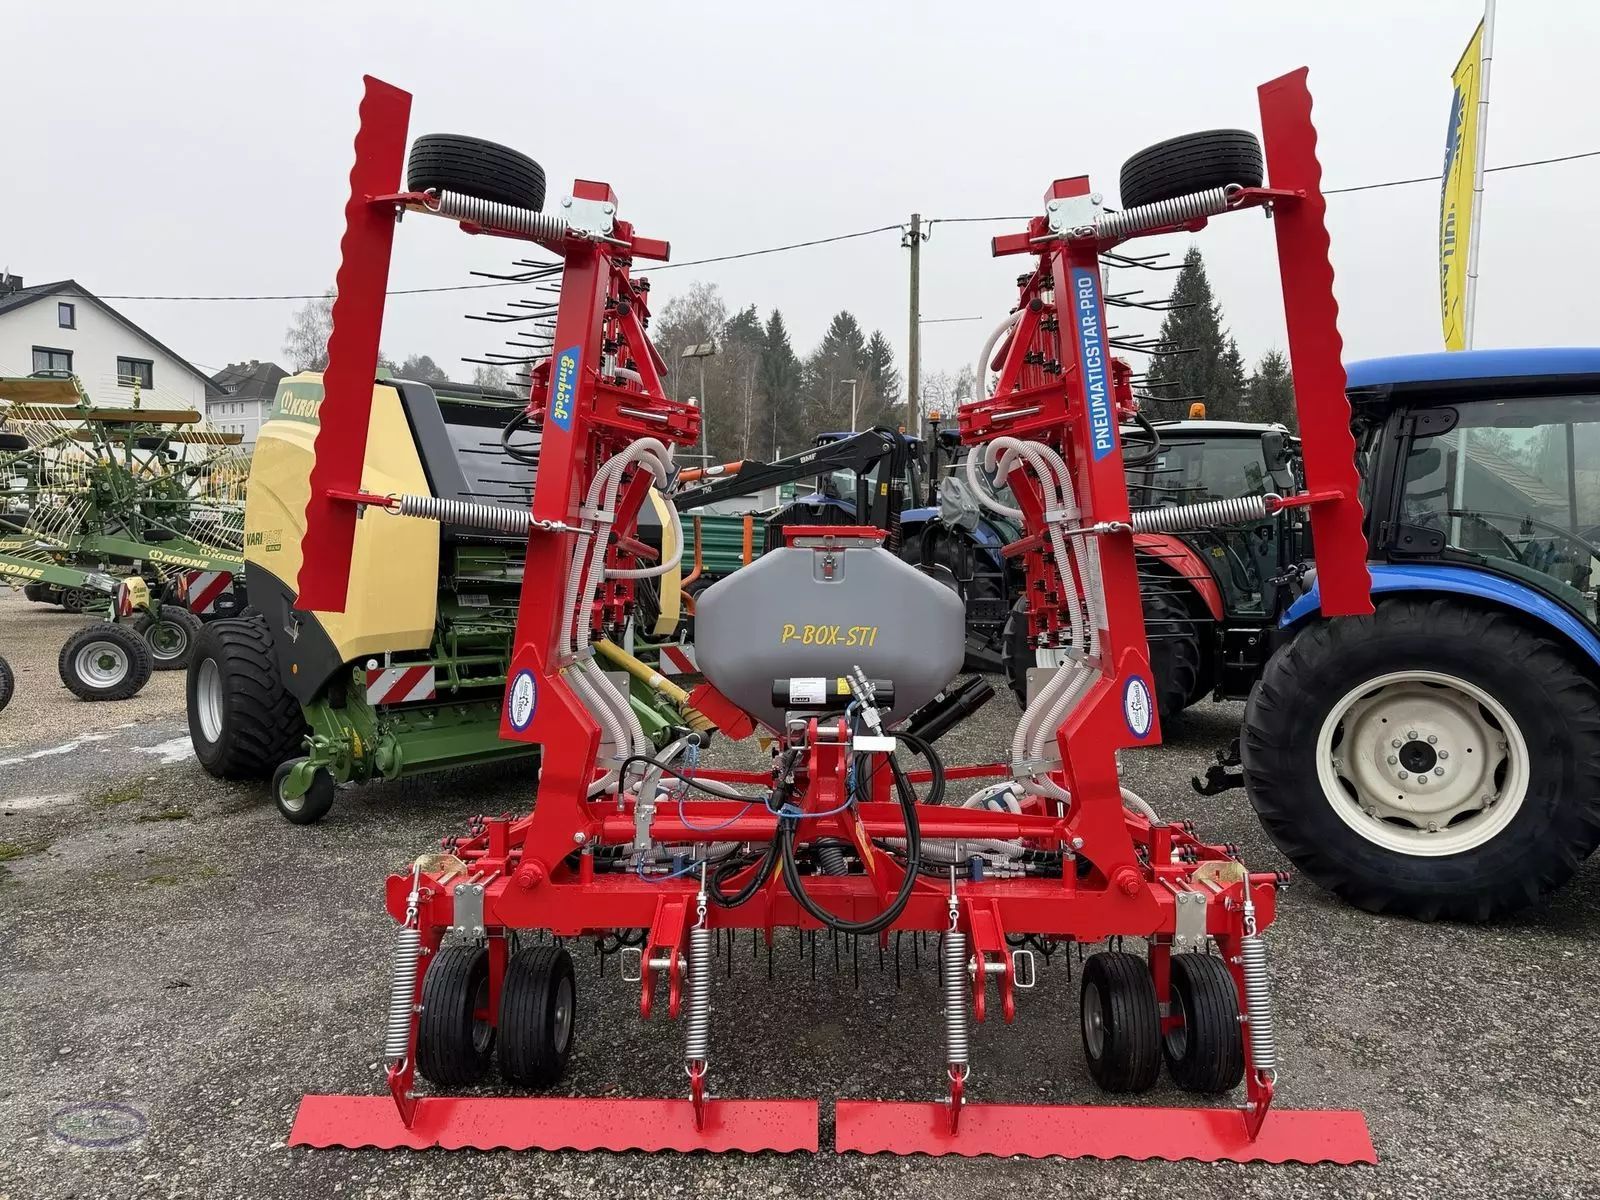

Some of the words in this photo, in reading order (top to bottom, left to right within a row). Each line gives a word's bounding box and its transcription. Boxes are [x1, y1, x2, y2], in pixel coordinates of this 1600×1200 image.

[1078, 277, 1111, 450] PNEUMATICSTAR-PRO
[555, 355, 575, 420] Einböck
[800, 453, 816, 463] BMF
[701, 486, 712, 495] 750
[162, 554, 211, 569] KRONE
[782, 624, 878, 647] P-BOX-STI
